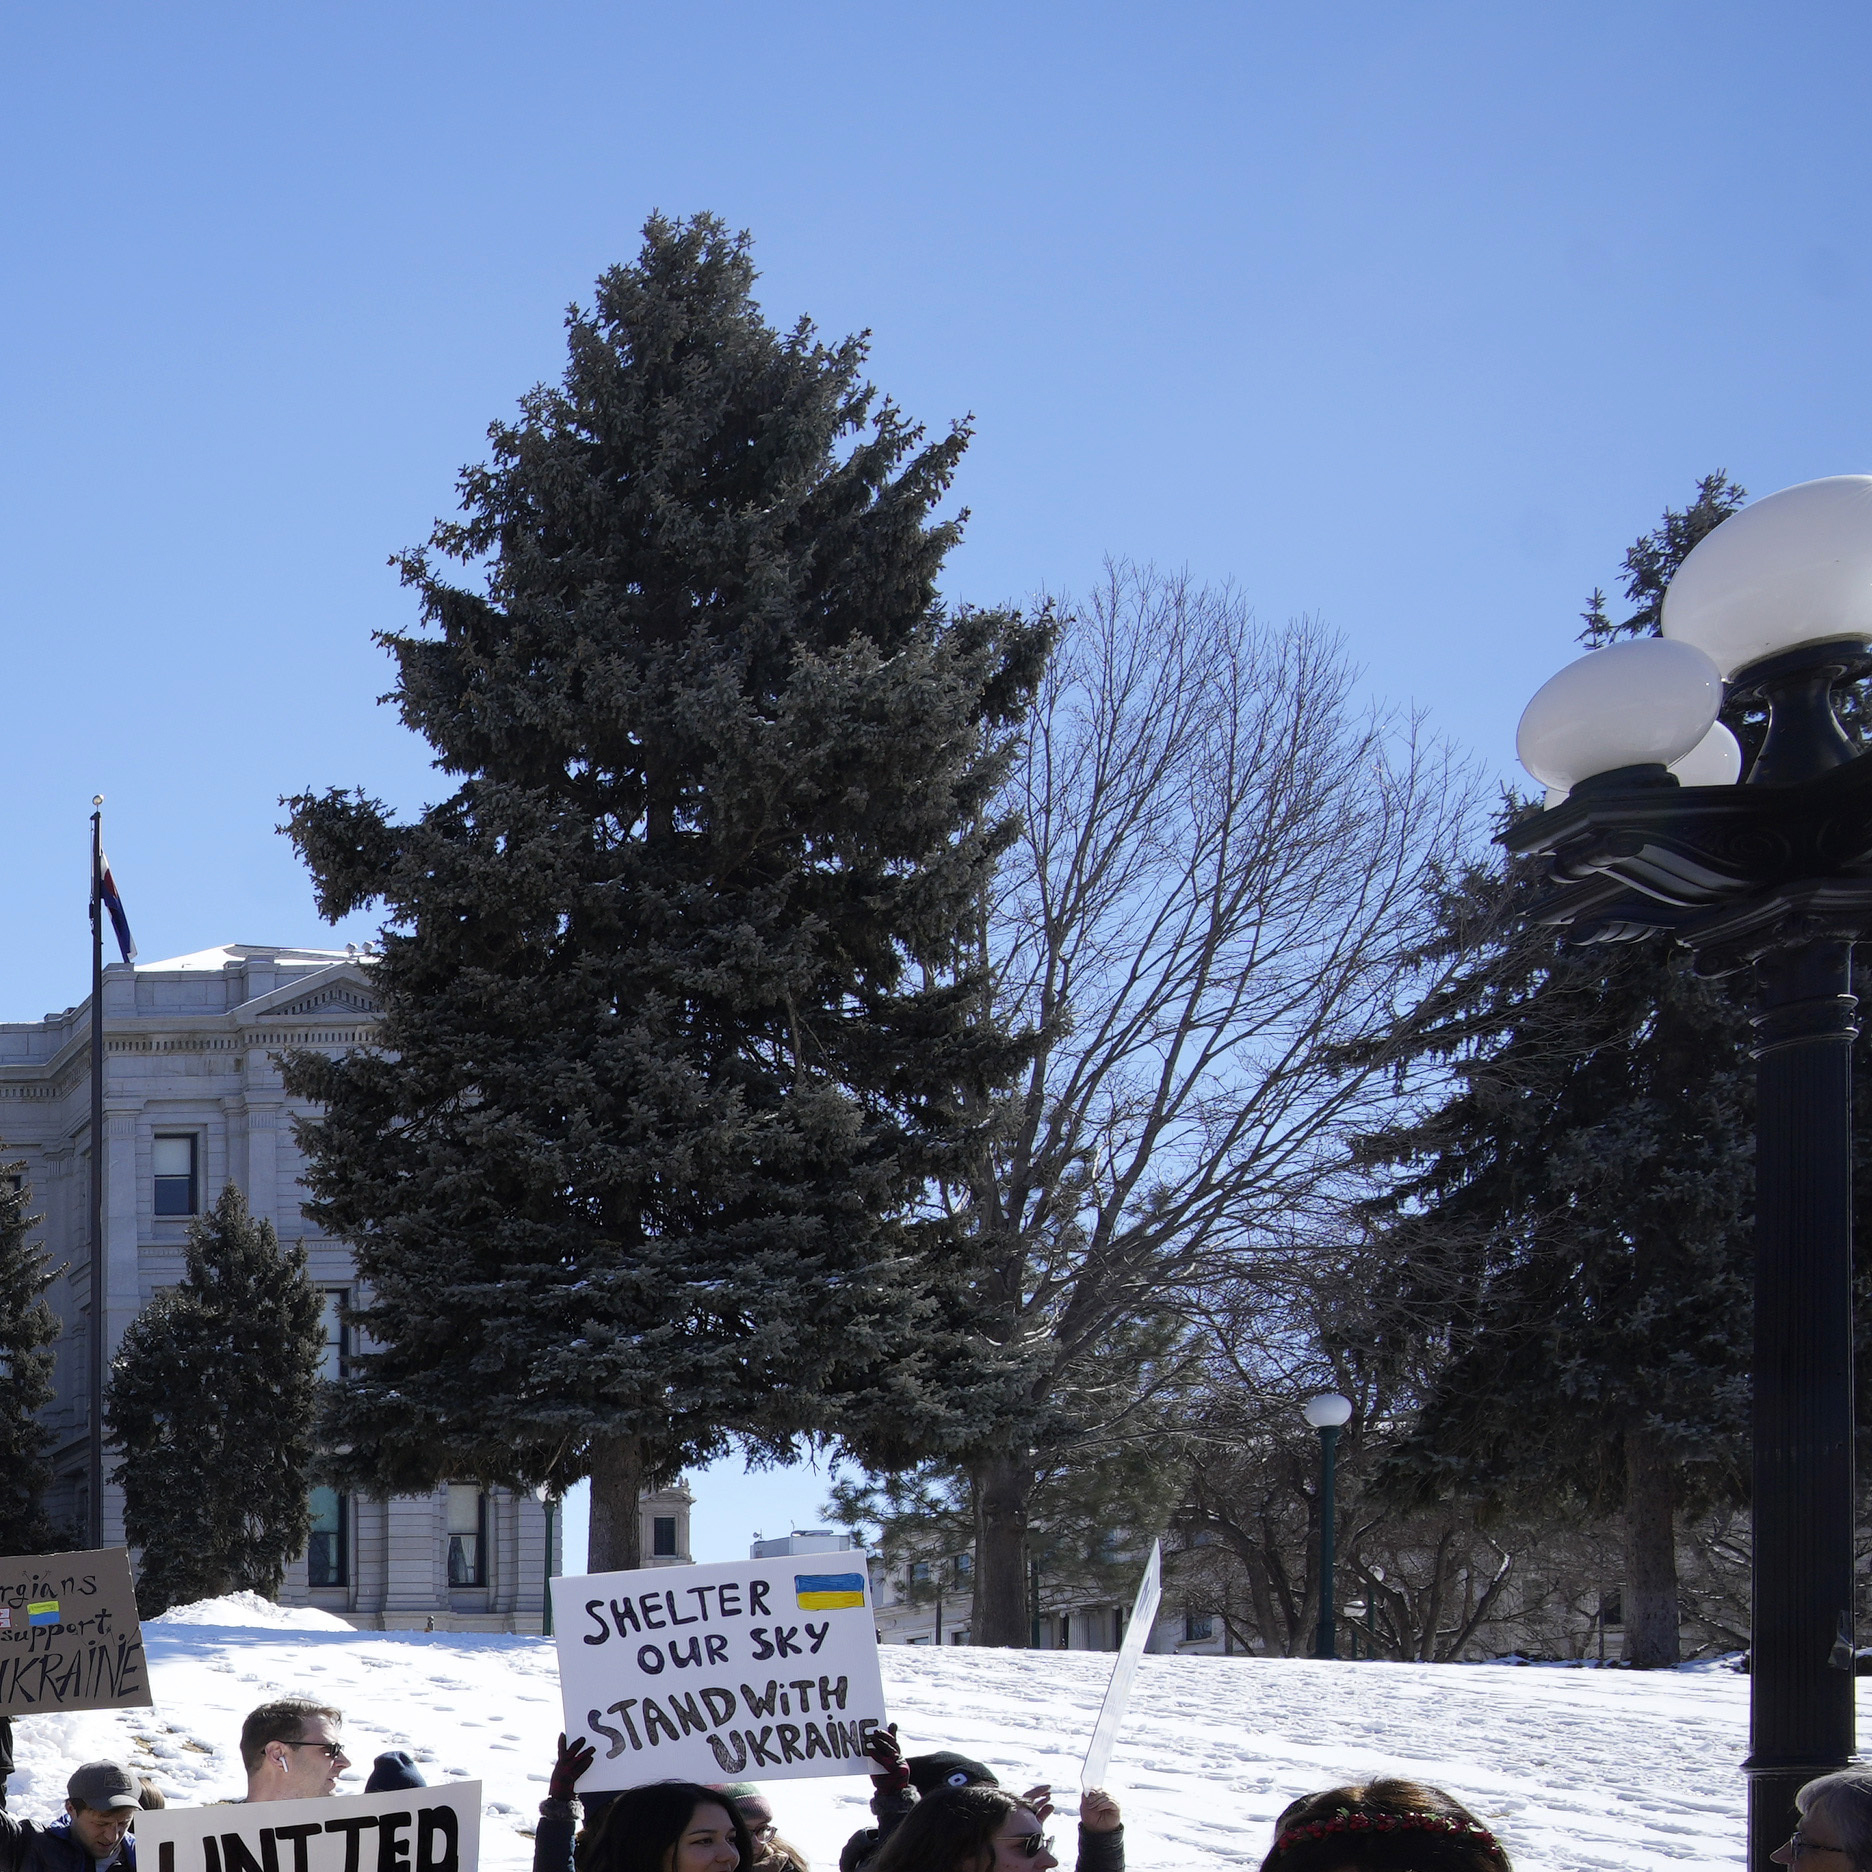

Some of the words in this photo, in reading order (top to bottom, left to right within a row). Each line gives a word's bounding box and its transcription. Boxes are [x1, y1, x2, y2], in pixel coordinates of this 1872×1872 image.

[1, 1608, 113, 1652] support
[583, 1579, 772, 1646] SHELTER
[637, 1634, 730, 1675] OUR
[749, 1621, 830, 1661] SKY
[587, 1686, 737, 1759] STAND
